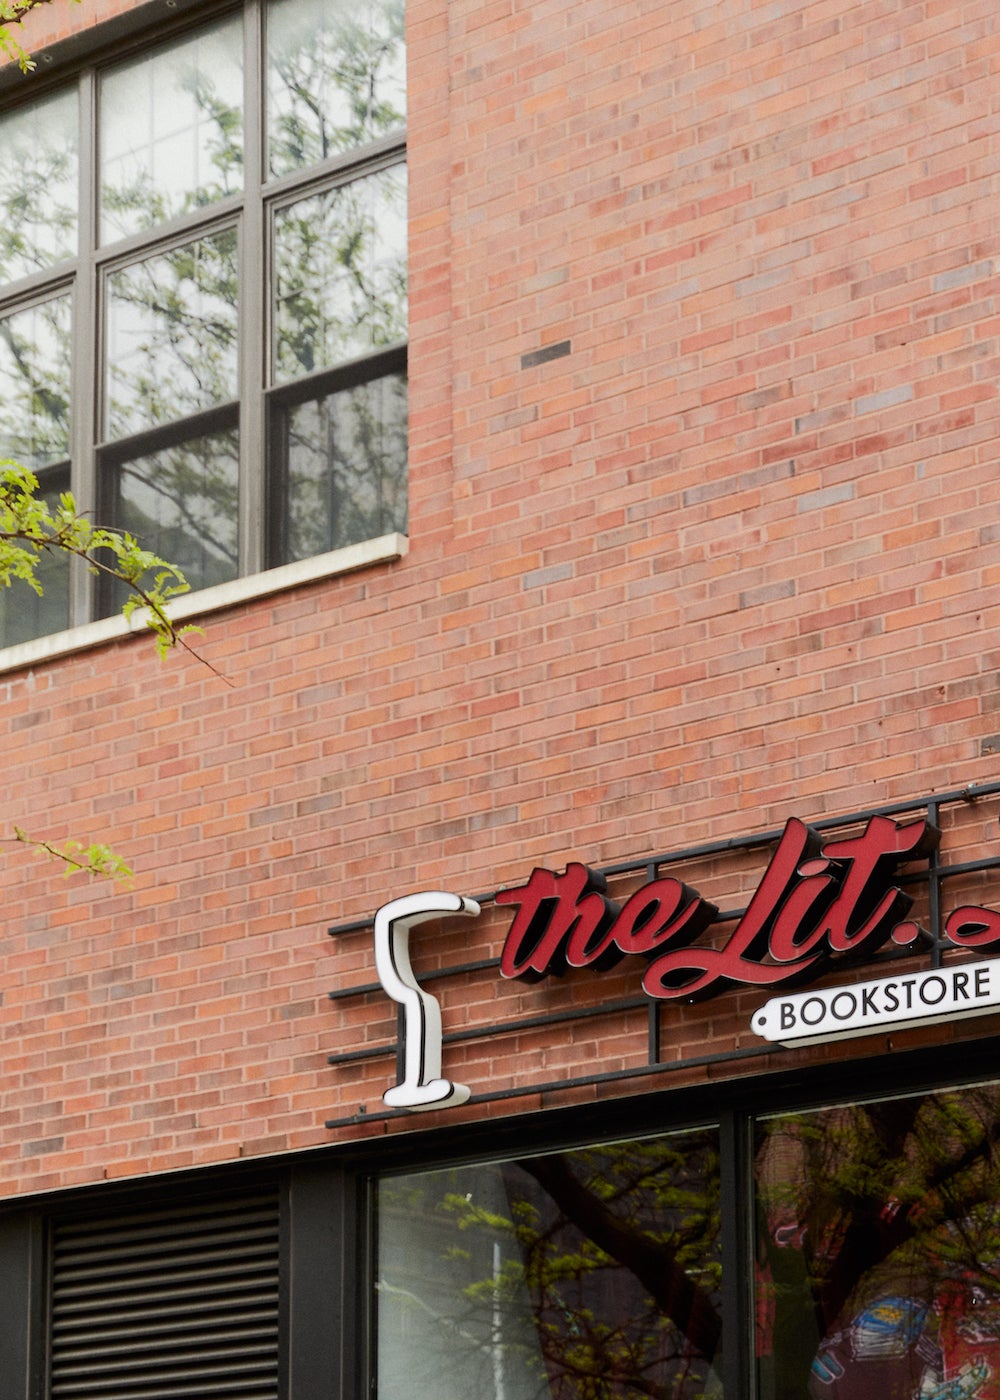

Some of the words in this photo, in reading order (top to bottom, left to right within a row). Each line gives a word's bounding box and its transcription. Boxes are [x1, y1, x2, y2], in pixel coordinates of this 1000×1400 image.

[495, 862, 706, 980] the
[642, 815, 929, 1000] Lit.
[779, 967, 990, 1031] BOOKSTORE
